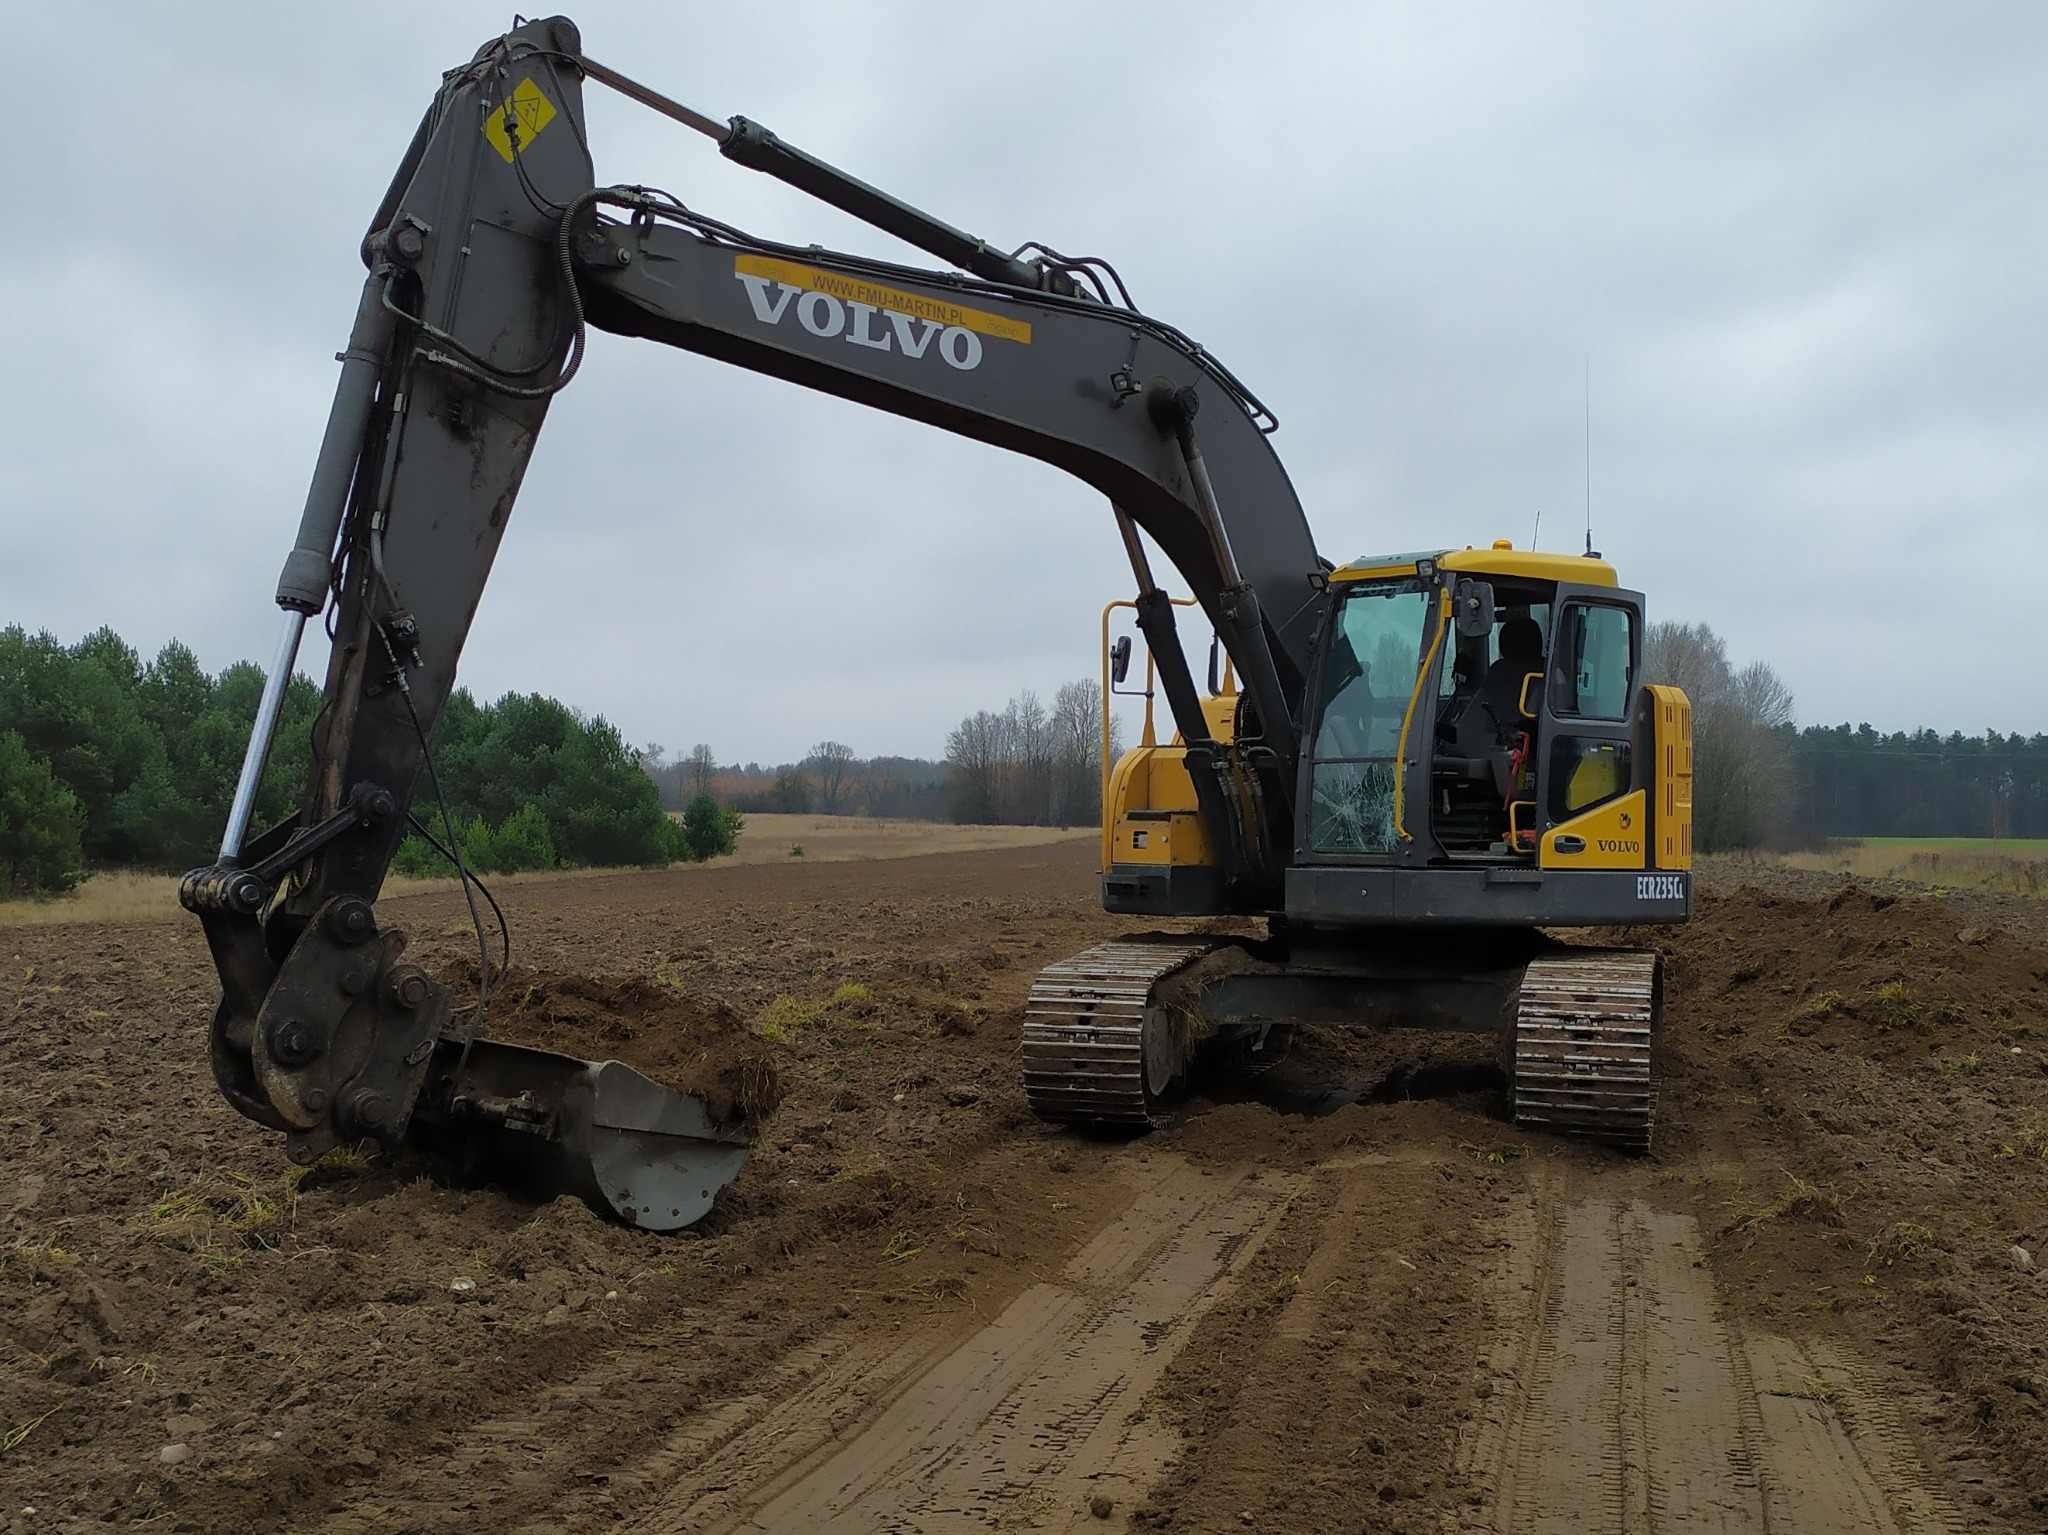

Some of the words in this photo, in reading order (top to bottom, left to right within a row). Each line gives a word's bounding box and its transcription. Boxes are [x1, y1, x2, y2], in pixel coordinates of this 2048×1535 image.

[735, 272, 983, 370] VOLVO
[811, 273, 967, 325] WWW.FMU-MARTIN.PL
[1598, 840, 1639, 853] VOLVO
